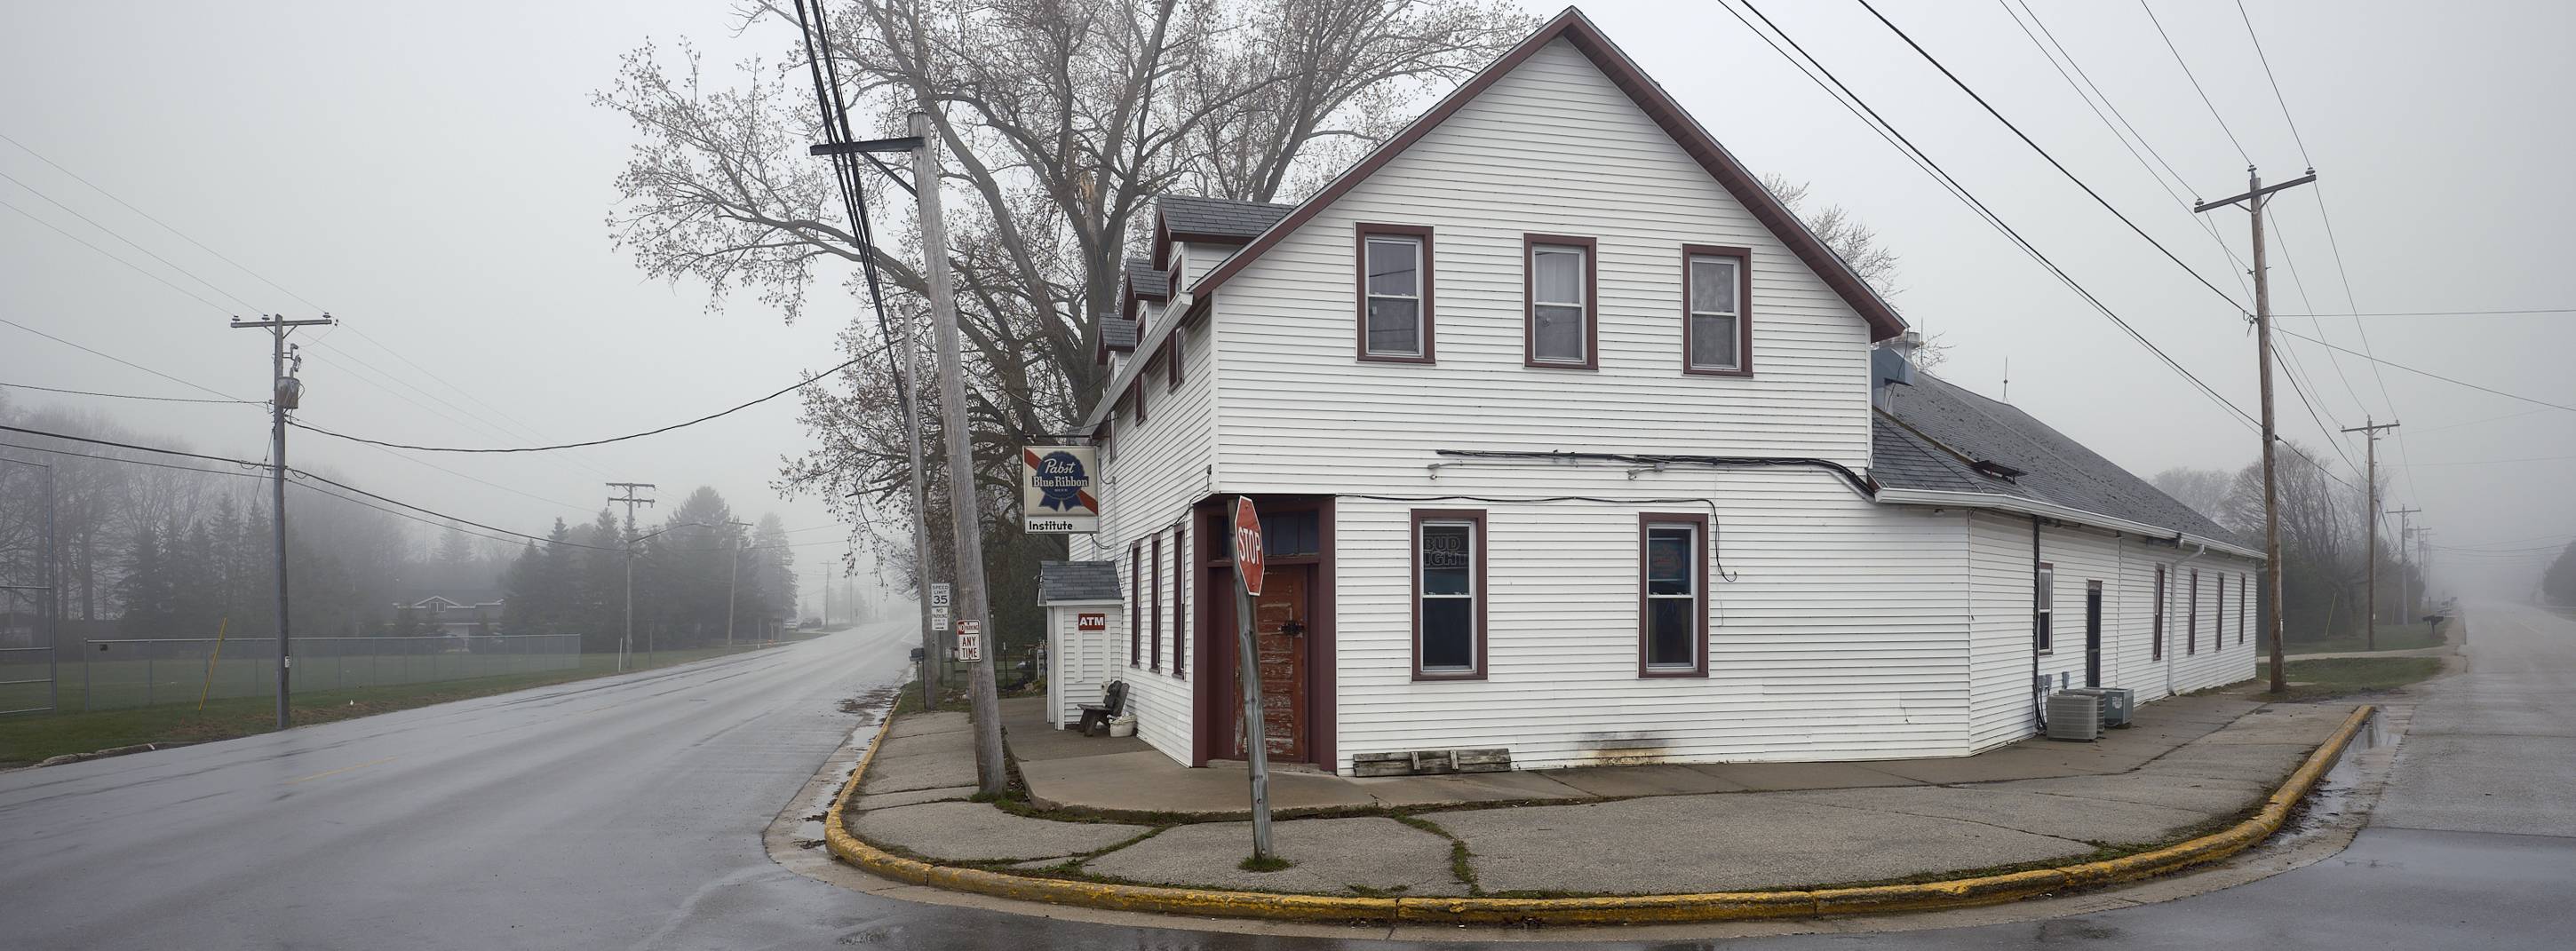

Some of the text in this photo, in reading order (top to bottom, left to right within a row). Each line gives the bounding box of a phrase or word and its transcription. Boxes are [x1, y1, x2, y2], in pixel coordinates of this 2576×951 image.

[1045, 458, 1076, 474] Pabst
[1033, 476, 1088, 487] Blue Ribbon
[1029, 520, 1073, 530] Institute
[1238, 527, 1260, 565] STOP
[1423, 536, 1460, 551] BUD
[1423, 551, 1468, 567] IGHT
[934, 595, 948, 604] 35
[1079, 616, 1104, 626] ATM
[962, 636, 976, 646] ANY
[962, 647, 977, 658] TIME
